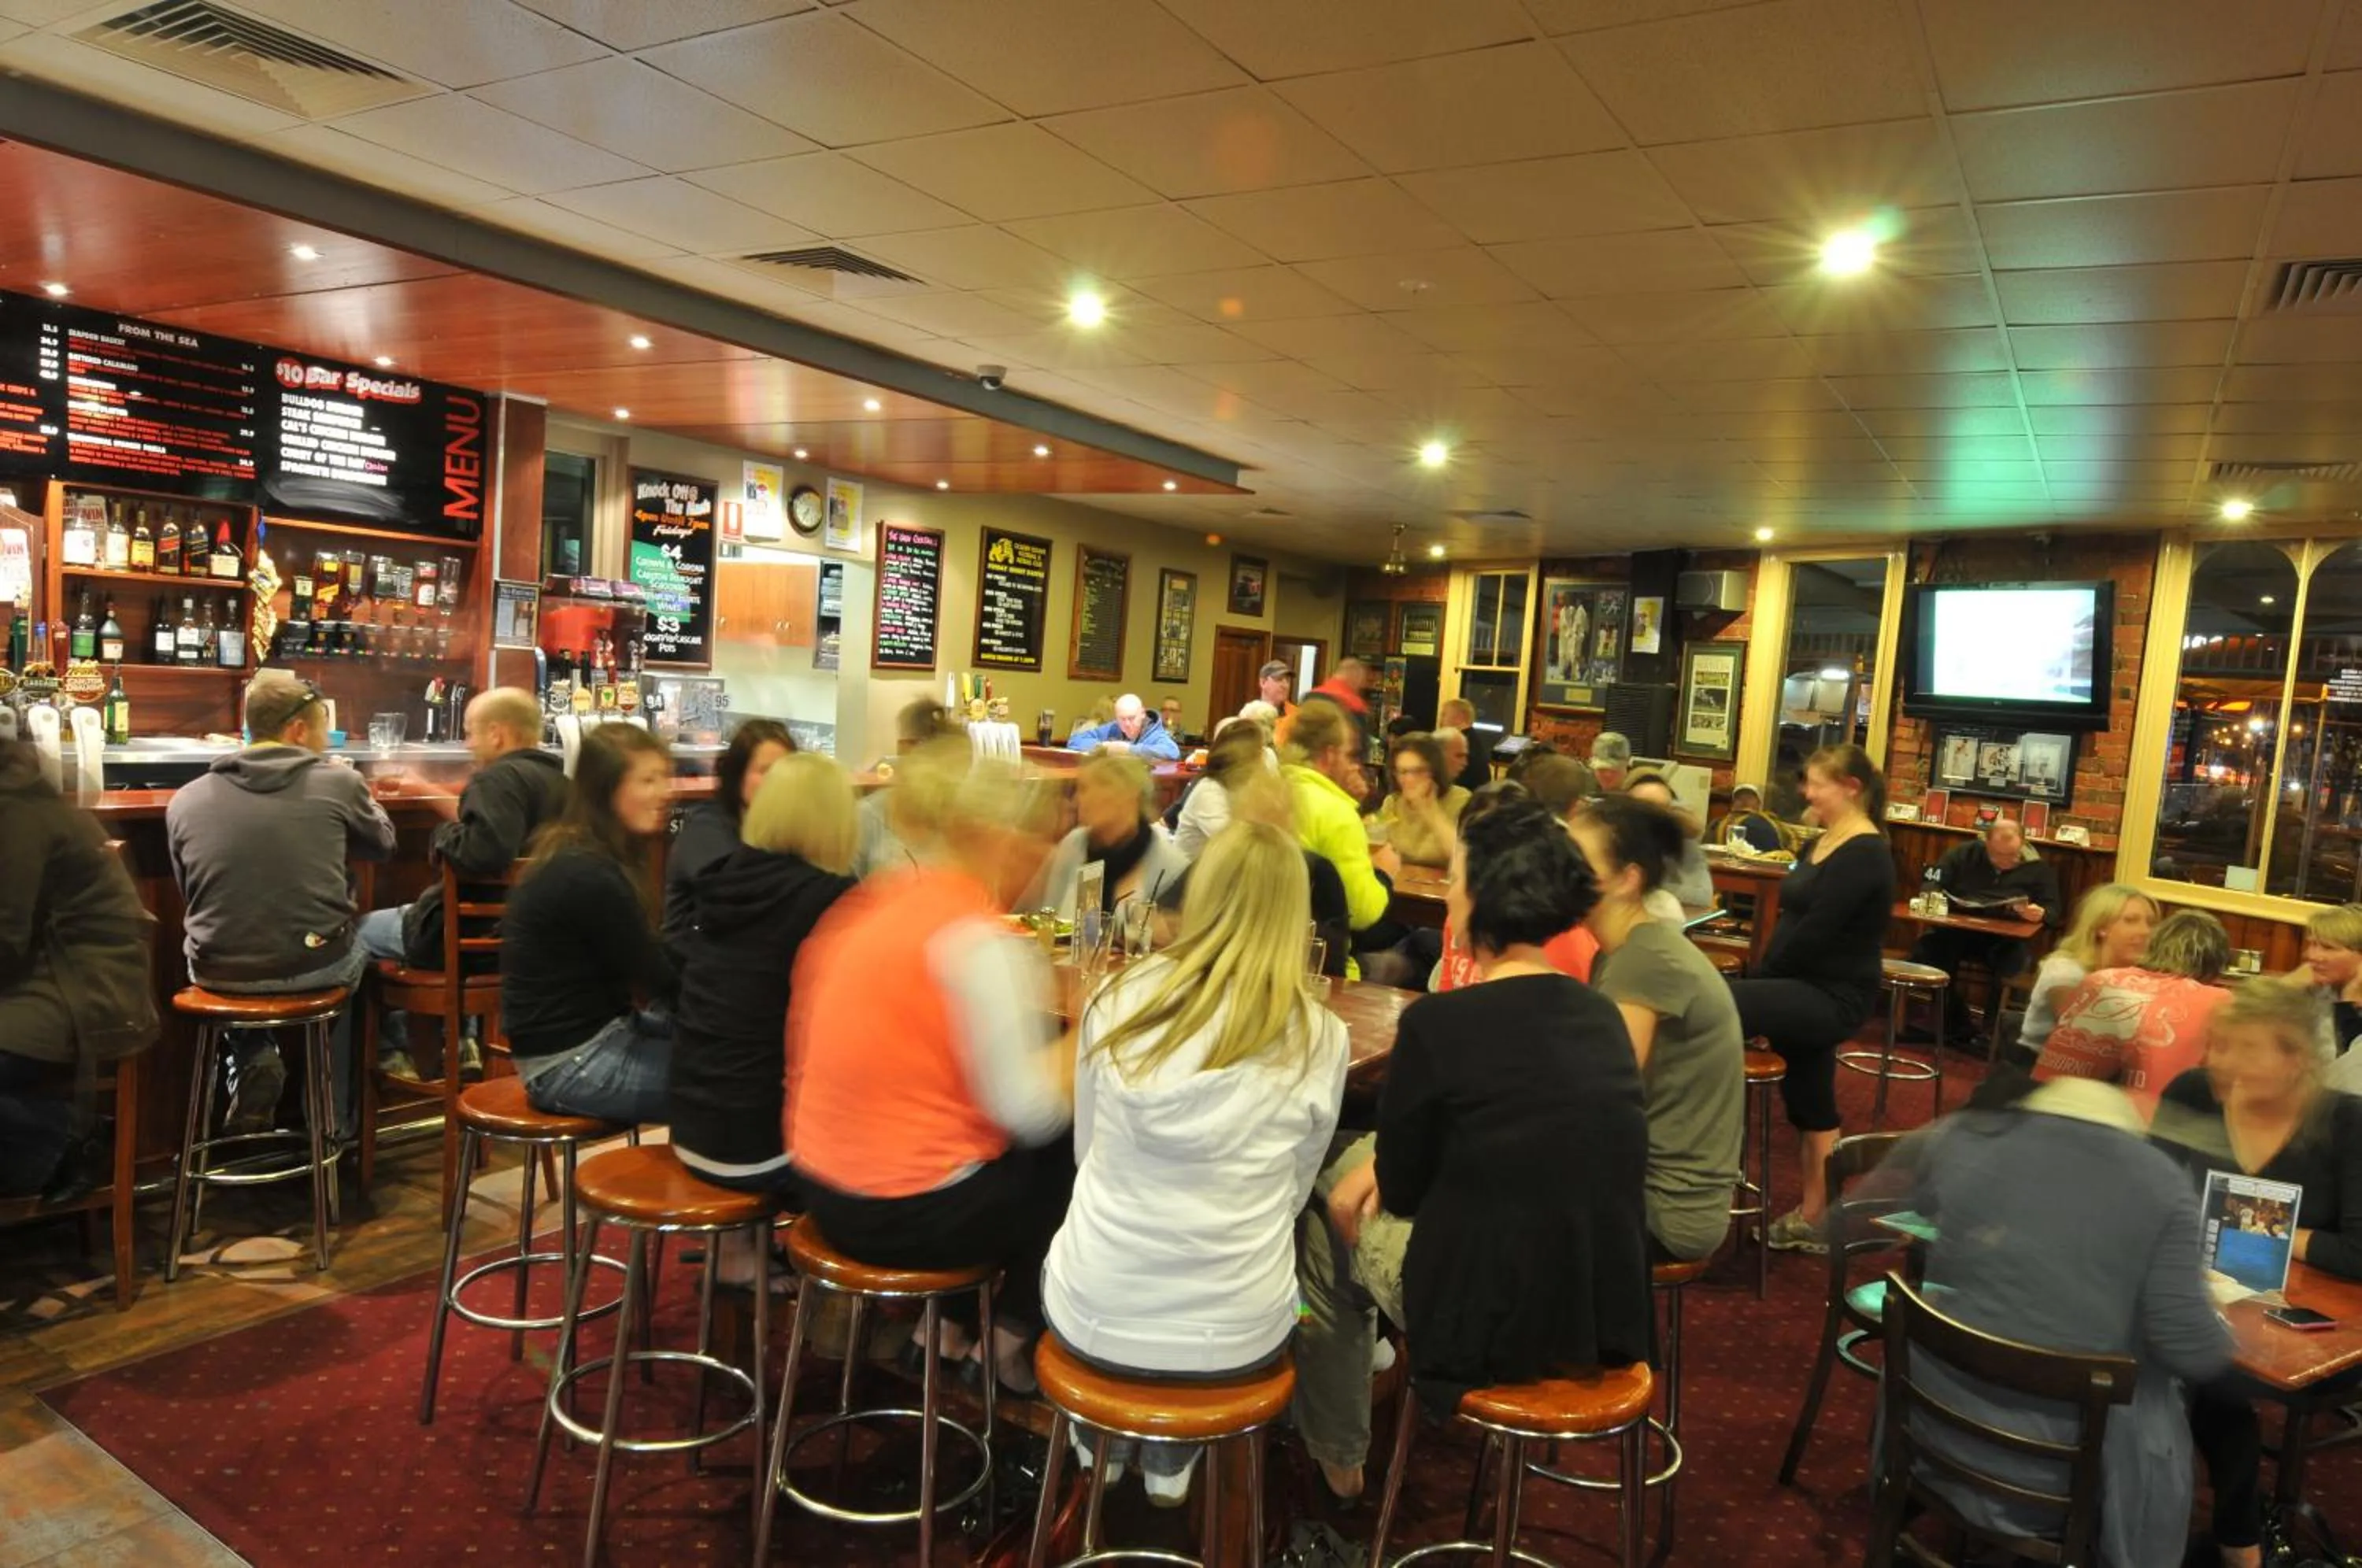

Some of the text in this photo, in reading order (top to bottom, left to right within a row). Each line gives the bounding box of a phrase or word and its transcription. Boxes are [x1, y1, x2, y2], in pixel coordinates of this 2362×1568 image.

[118, 324, 198, 348] FROM THE SEA
[276, 362, 304, 384] $10
[305, 366, 342, 386] Bar
[346, 372, 421, 400] Specials
[443, 394, 481, 520] MENU
[637, 483, 671, 501] Knock
[665, 499, 684, 516] The
[661, 543, 683, 560] $4
[657, 616, 681, 633] $3
[646, 694, 729, 709] 94 95
[1924, 867, 1942, 882] 44
